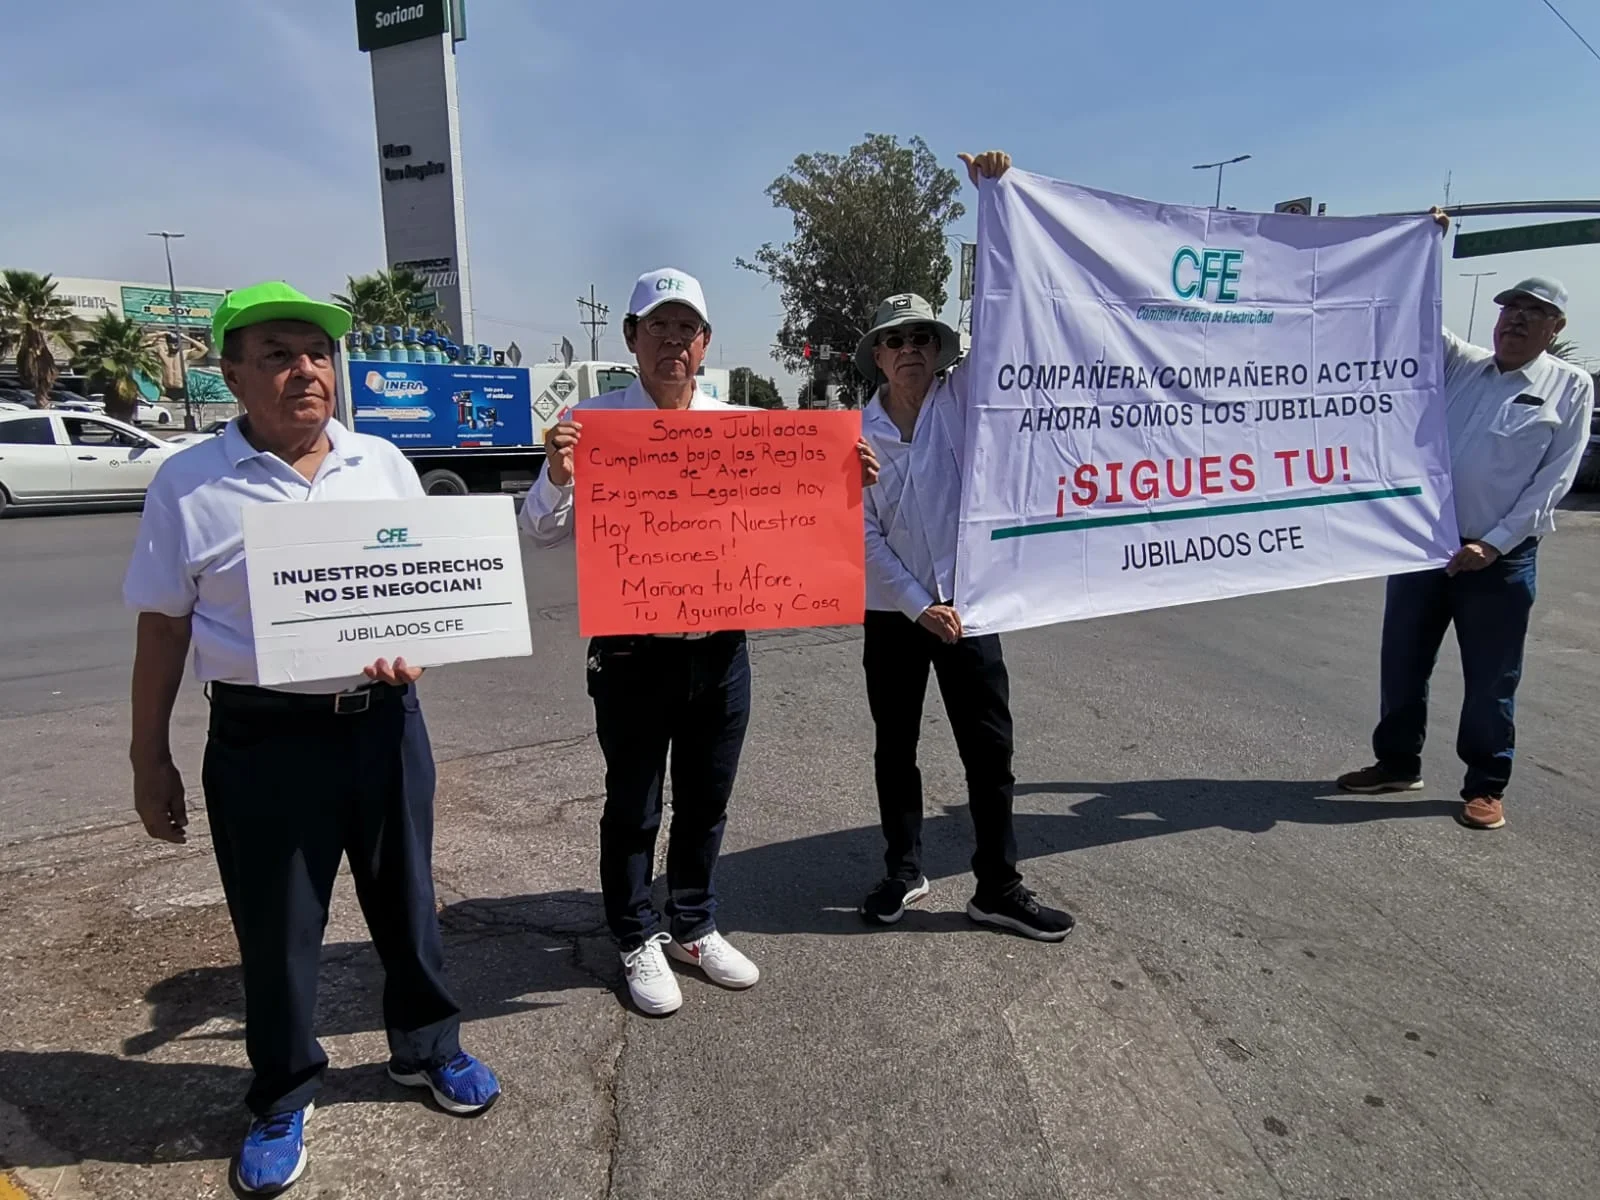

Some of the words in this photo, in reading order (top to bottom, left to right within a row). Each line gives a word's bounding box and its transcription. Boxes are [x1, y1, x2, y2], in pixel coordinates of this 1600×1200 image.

[375, 4, 424, 28] Soriana
[656, 278, 686, 292] CFE
[1171, 246, 1244, 303] CFE
[1137, 306, 1177, 320] Comisión
[1178, 308, 1209, 322] Federal
[1212, 311, 1223, 322] de
[1224, 310, 1274, 324] Electricidad
[998, 361, 1308, 391] COMPAÑERA/COMPAÑERO
[1318, 358, 1419, 384] ACTIVO
[1019, 406, 1101, 432] AHORA
[1111, 403, 1193, 428] SOMOS
[1202, 402, 1246, 425] LOS
[1254, 394, 1393, 422] JUBILADOS
[649, 420, 712, 441] Somos
[720, 414, 818, 438] Jubilados
[590, 448, 679, 476] Cumplimos
[687, 444, 720, 470] bajo
[680, 466, 702, 480] de
[716, 463, 758, 480] Ayer
[592, 482, 678, 507] Exigimos
[690, 480, 782, 506] Legalidad
[796, 480, 825, 500] hoy
[1056, 453, 1256, 517] ¡SIGUES
[1275, 446, 1351, 487] TU!
[376, 528, 408, 543] CFE
[592, 514, 630, 544] Hoy
[640, 510, 722, 536] Robaron
[1122, 532, 1252, 570] JUBILADOS
[1258, 526, 1304, 554] CFE
[273, 563, 398, 586] ¡NUESTROS
[402, 558, 504, 576] DERECHOS
[622, 576, 704, 600] Mañana
[712, 569, 732, 594] tu
[304, 588, 337, 604] NO
[342, 585, 368, 600] SE
[374, 578, 482, 598] NEGOCIAN!
[624, 600, 658, 621] Tu
[676, 594, 766, 626] Aguinaldo
[774, 602, 783, 619] y
[337, 620, 431, 642] JUBILADOS
[434, 619, 464, 632] CFE
